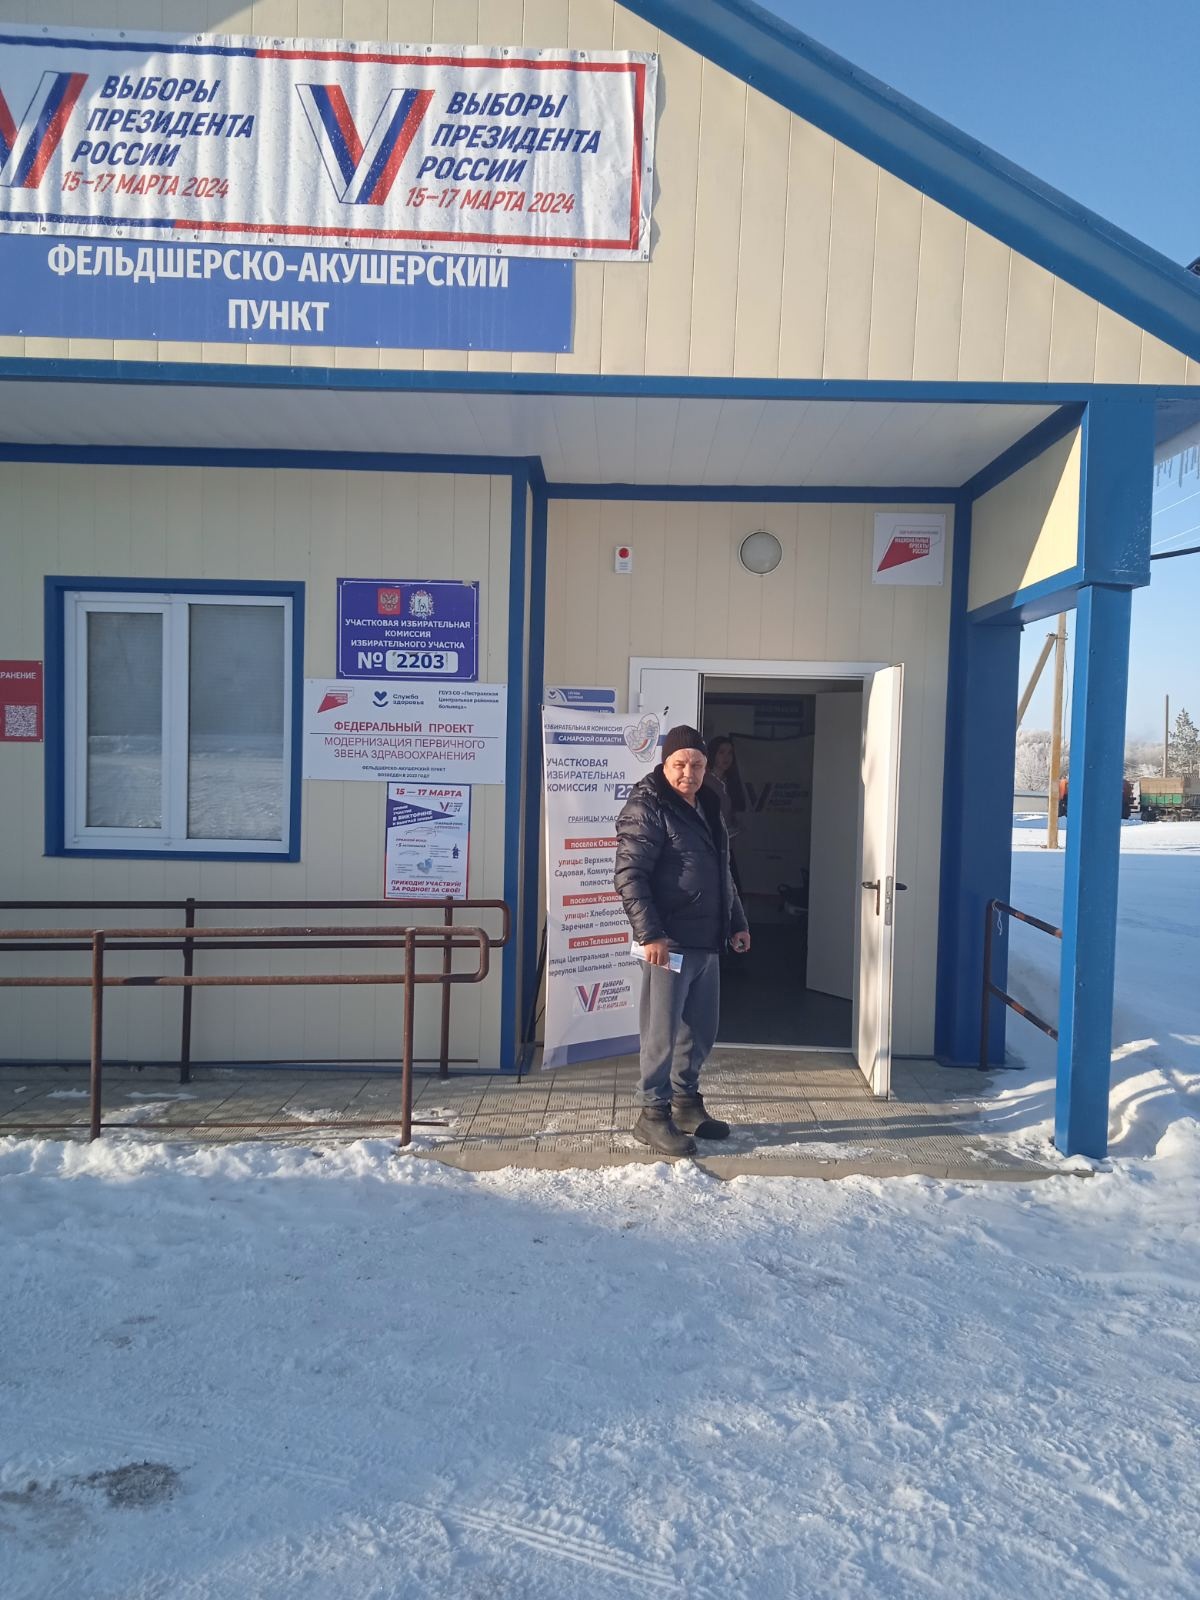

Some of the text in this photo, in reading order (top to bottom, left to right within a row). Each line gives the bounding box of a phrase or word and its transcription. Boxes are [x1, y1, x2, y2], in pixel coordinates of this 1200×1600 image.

[100, 75, 221, 102] ВЫБОРЫ
[446, 91, 568, 118] ВЫБОРЫ
[86, 107, 255, 138] ПРЕЗИДЕНТА
[431, 123, 601, 153] ПРЕЗИДЕНТА
[71, 141, 181, 167] РОССИИ
[416, 156, 527, 182] РОССИИ
[116, 174, 180, 196] МАРТА
[182, 177, 229, 198] 2024
[460, 188, 525, 212] МАРТА
[527, 192, 575, 214] 2024
[228, 299, 329, 332] ПУНКТ
[345, 618, 471, 629] УЧАСТКОВАЯ ИЗБИРАТЕЛЬНАЯ
[384, 630, 431, 638] КОМИССИЯ
[351, 639, 465, 649] ИЗБИРАТЕЛЬНОГО УЧАСТКА
[396, 653, 445, 669] 2203
[0, 671, 37, 680] РАНЕНИЕ
[392, 693, 419, 702] Служба
[334, 721, 475, 734] ФЕДЕРАЛЬНЫЙ ПРОЕКТ
[591, 725, 623, 733] КОМИССИЯ
[324, 736, 485, 750] МОДЕРНИЗАЦИЯ ПЕРВИЧНОГО
[558, 734, 595, 742] САМАРСКОЙ
[334, 749, 476, 761] ЗВЕНА ЗДРАВООХРАНЕНИЯ
[546, 758, 608, 767] УЧАСТКОВАЯ
[546, 770, 626, 780] ИЗБИРАТЕЛЬНАЯ
[429, 789, 463, 797] МАРТА
[546, 783, 598, 792] КОМИССИЯ
[568, 815, 599, 823] ГРАНИЦЫ
[571, 840, 597, 849] поселок
[558, 859, 583, 868] улицы:
[554, 869, 586, 878] Садовая,
[564, 912, 589, 921] улицы:
[561, 922, 593, 932] Заречная
[573, 936, 625, 948] село Телешовка
[567, 953, 610, 964] Центральная
[577, 961, 612, 973] Школьный
[602, 979, 625, 989] ВЫБОРЫ
[600, 985, 631, 996] ПРЕЗИДЕНТА
